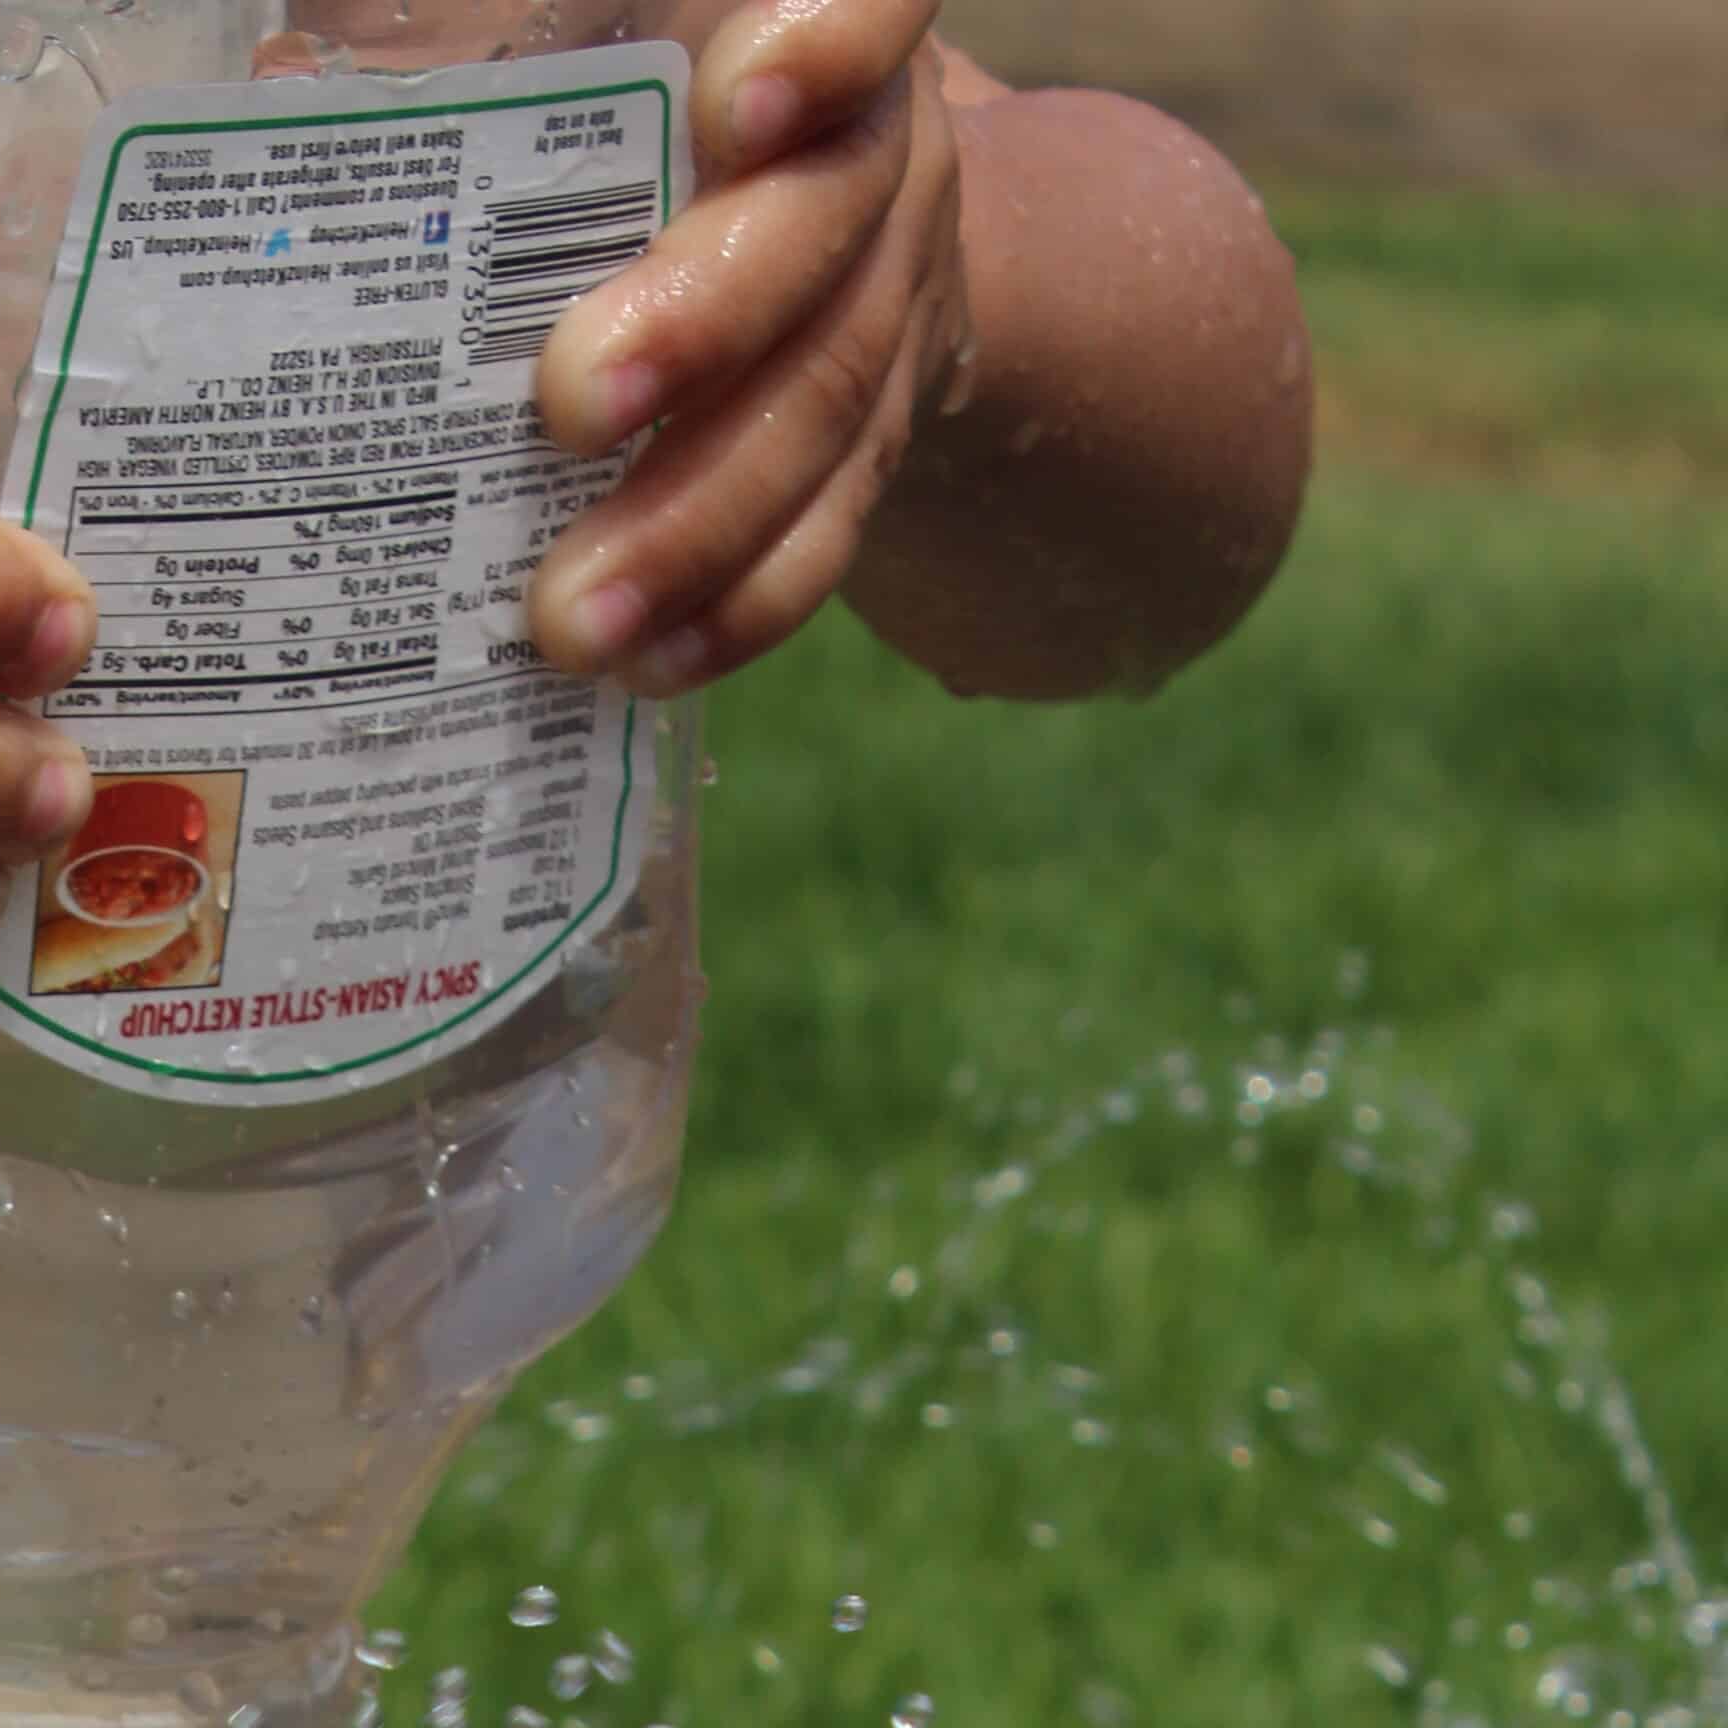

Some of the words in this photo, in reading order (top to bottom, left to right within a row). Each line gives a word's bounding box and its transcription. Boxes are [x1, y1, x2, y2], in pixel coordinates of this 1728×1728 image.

[334, 137, 382, 159] before
[385, 134, 416, 155] well
[420, 129, 464, 151] Shake
[264, 142, 296, 161] use.
[299, 141, 331, 162] first
[260, 163, 341, 188] refrigerate
[345, 159, 399, 184] results,
[402, 158, 433, 179] best
[435, 155, 461, 176] For
[146, 169, 216, 195] opening.
[219, 172, 256, 193] after
[388, 179, 459, 204] Questions
[279, 187, 366, 213] comments?
[368, 186, 384, 202] or
[115, 197, 240, 221] 1-800-255-5750
[244, 195, 276, 216] Call
[336, 257, 390, 280] online:
[394, 255, 412, 271] us
[415, 252, 449, 273] Visit
[178, 260, 331, 291] HeinzKetchup.com
[352, 279, 449, 306] GLUTEN-FREE
[268, 349, 313, 370] 15222
[320, 346, 340, 367] PA
[345, 336, 443, 364] PITTSBURGH,
[265, 372, 313, 395] HEINZ
[319, 370, 348, 390] H.J.
[350, 368, 372, 388] OF
[374, 361, 441, 385] DIVISION
[299, 393, 344, 416] U.S.A.
[347, 391, 375, 411] THE
[381, 390, 396, 407] IN
[402, 385, 438, 405] MFD.
[78, 405, 154, 427] AMERICA
[156, 403, 215, 424] NORTH
[216, 400, 266, 421] HEINZ
[269, 398, 291, 418] BY
[482, 403, 513, 423] CORN
[205, 430, 263, 452] NATURAL
[327, 422, 366, 442] ONION
[426, 426, 508, 454] CONCENTRATE
[327, 446, 355, 465] RIPE
[359, 443, 385, 462] RED
[388, 438, 423, 459] FROM
[76, 460, 111, 479] HIGH
[182, 453, 249, 476] DISTILLED
[371, 478, 393, 494] 2%
[396, 478, 406, 491] A
[410, 470, 457, 489] Vitamin
[107, 494, 138, 510] Iron
[153, 493, 177, 510] 0%
[182, 491, 243, 507] Calcium
[258, 488, 282, 504] 2%
[288, 487, 301, 502] C
[304, 482, 357, 501] Vitamin
[79, 494, 104, 511] 0%
[326, 510, 381, 535] 160mg
[388, 504, 455, 526] Sodium
[292, 519, 323, 540] 7%
[183, 556, 260, 574] Protein
[288, 552, 320, 571] 0%
[334, 543, 372, 566] 0mg
[153, 555, 178, 577] 0g
[483, 562, 502, 580] 73
[338, 575, 361, 598] 0g
[364, 576, 390, 596] Fat
[395, 570, 437, 589] Trans
[150, 586, 174, 610] 4g
[179, 586, 245, 606] Sugars
[446, 588, 485, 615] (17g)
[488, 584, 522, 604] Tbsp
[281, 616, 312, 634] 0%
[349, 606, 372, 628] 0g
[374, 607, 400, 625] Fat
[163, 618, 188, 641] 0g
[193, 622, 240, 639] Fiber
[331, 640, 354, 662] 0g
[360, 640, 390, 659] Fat
[395, 633, 438, 654] Total
[101, 651, 126, 673] 5g
[132, 654, 189, 673] Carb.
[193, 653, 245, 671] Total
[277, 648, 308, 667] 0%
[115, 690, 240, 706] Amount/serving
[165, 747, 212, 766] flavors
[358, 815, 386, 835] and
[389, 804, 446, 829] Scallions
[252, 824, 297, 849] Seeds
[300, 816, 357, 842] Sesame
[379, 884, 420, 905] Sauce
[411, 960, 482, 1006] SPICY
[247, 975, 412, 1028] ASIAN-STYLE
[117, 996, 246, 1038] KETCHUP
